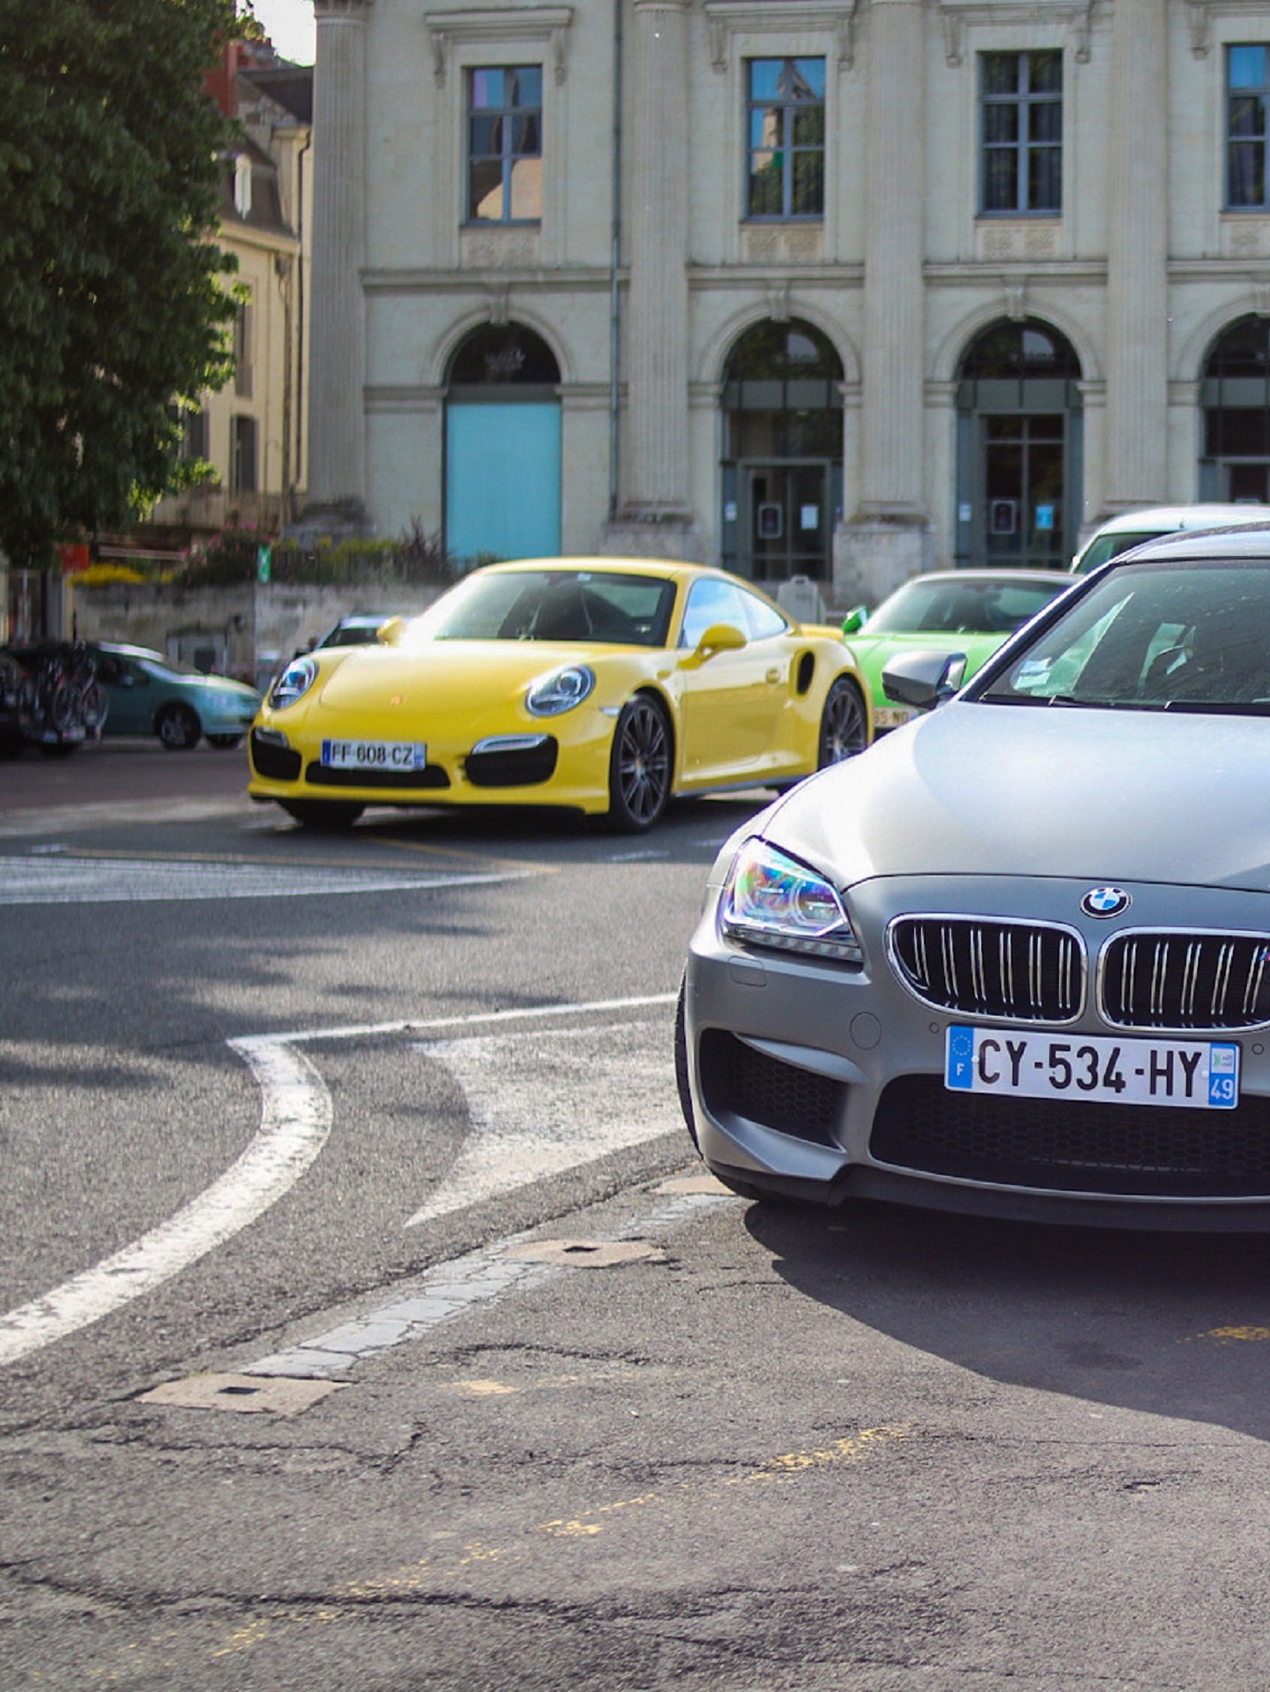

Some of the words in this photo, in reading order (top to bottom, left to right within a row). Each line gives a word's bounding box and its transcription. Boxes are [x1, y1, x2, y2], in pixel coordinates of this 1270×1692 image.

[956, 1063, 965, 1077] F
[978, 1039, 1202, 1098] CY-534-HY
[1210, 1078, 1234, 1100] 49
